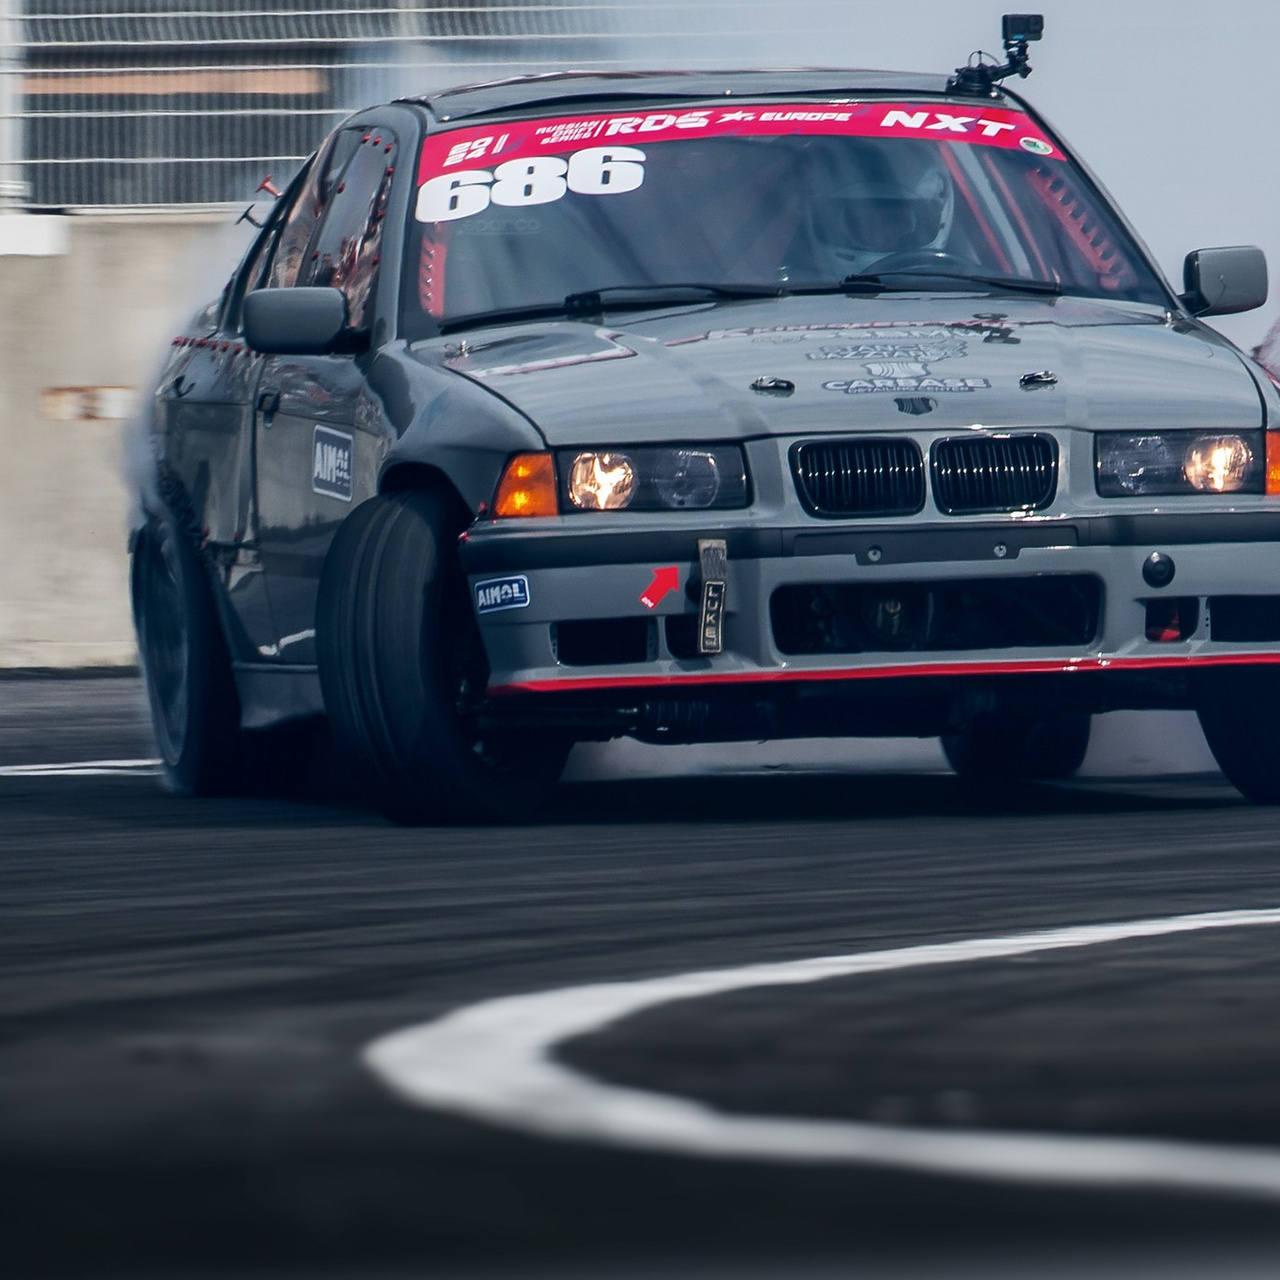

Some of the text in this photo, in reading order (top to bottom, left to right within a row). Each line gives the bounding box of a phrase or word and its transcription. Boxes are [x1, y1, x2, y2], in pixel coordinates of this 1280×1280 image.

[605, 110, 853, 137] RDS EUROPE
[880, 110, 1016, 137] NXT
[415, 146, 647, 224] 686
[825, 378, 988, 391] CARBASE
[313, 442, 351, 481] AIMOL
[477, 582, 526, 608] AIMOL
